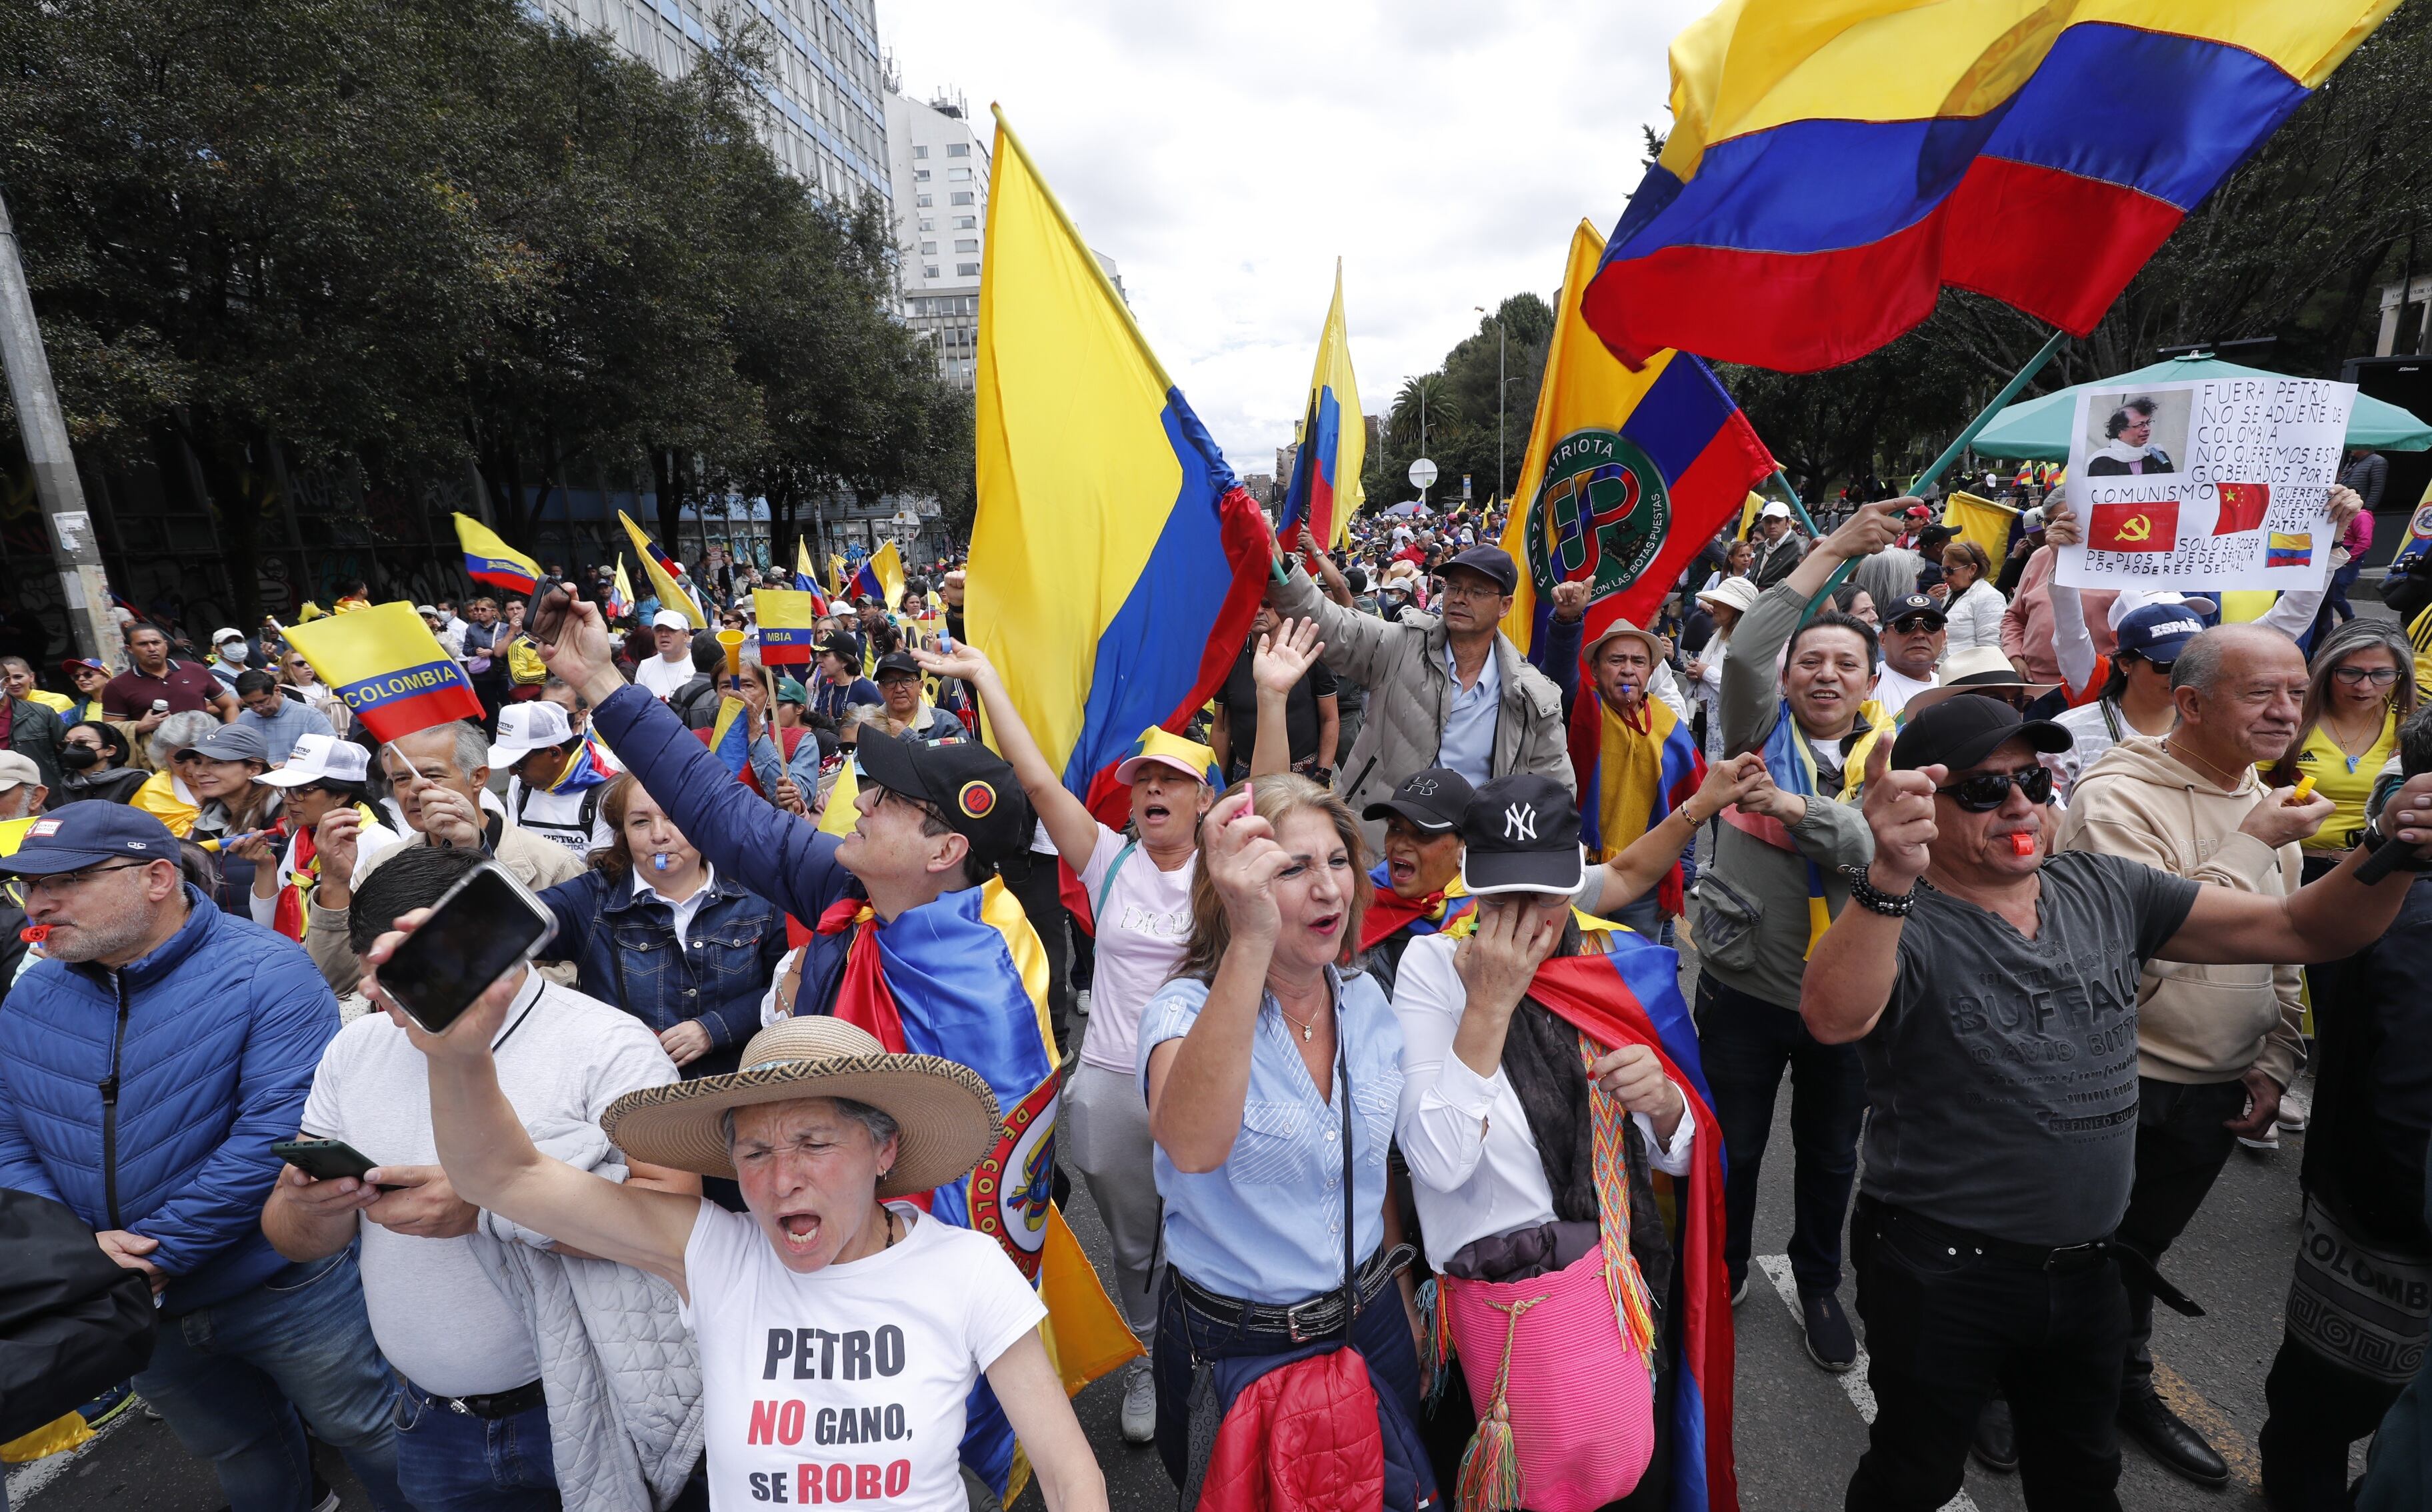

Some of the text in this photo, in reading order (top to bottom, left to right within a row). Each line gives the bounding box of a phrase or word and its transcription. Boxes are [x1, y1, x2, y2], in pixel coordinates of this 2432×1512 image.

[2204, 381, 2331, 404] FUERA PETRO
[2201, 403, 2342, 424] NO SE ADUEÑE DE
[2198, 426, 2278, 444] COLOMBIA
[2196, 445, 2226, 463] NO
[2233, 445, 2310, 465] QUEREMOS
[2192, 464, 2291, 483] GOBERNADOS
[2297, 467, 2321, 483] POR
[2091, 484, 2213, 503] COMUNISMO
[2273, 499, 2325, 508] DEFENDE
[1532, 439, 1613, 588] FUERZA PATRIOTA
[2271, 508, 2325, 519] NUESTRA
[2267, 520, 2309, 532] PATRIA
[1590, 493, 1662, 597] CON LAS BOTAS PUESTAS
[2179, 537, 2259, 552] SOLO EL PODER
[2085, 562, 2244, 575] LOS PODERES DEL MAL
[2087, 551, 2255, 565] DE DIOS PUEDE DESTRUIR
[765, 632, 792, 642] MBIA
[2149, 617, 2203, 638] ESPAÑA
[343, 666, 458, 708] COLOMBIA
[1504, 802, 1537, 841] NY
[1949, 950, 2141, 1036] BUFFALO
[1971, 1040, 2076, 1065] DAVID
[2113, 1079, 2133, 1097] GOODS
[1003, 1107, 1030, 1141] DE
[762, 1324, 905, 1381] PETRO
[747, 1399, 913, 1445] NO GANO,
[749, 1459, 911, 1504] SE ROBO
